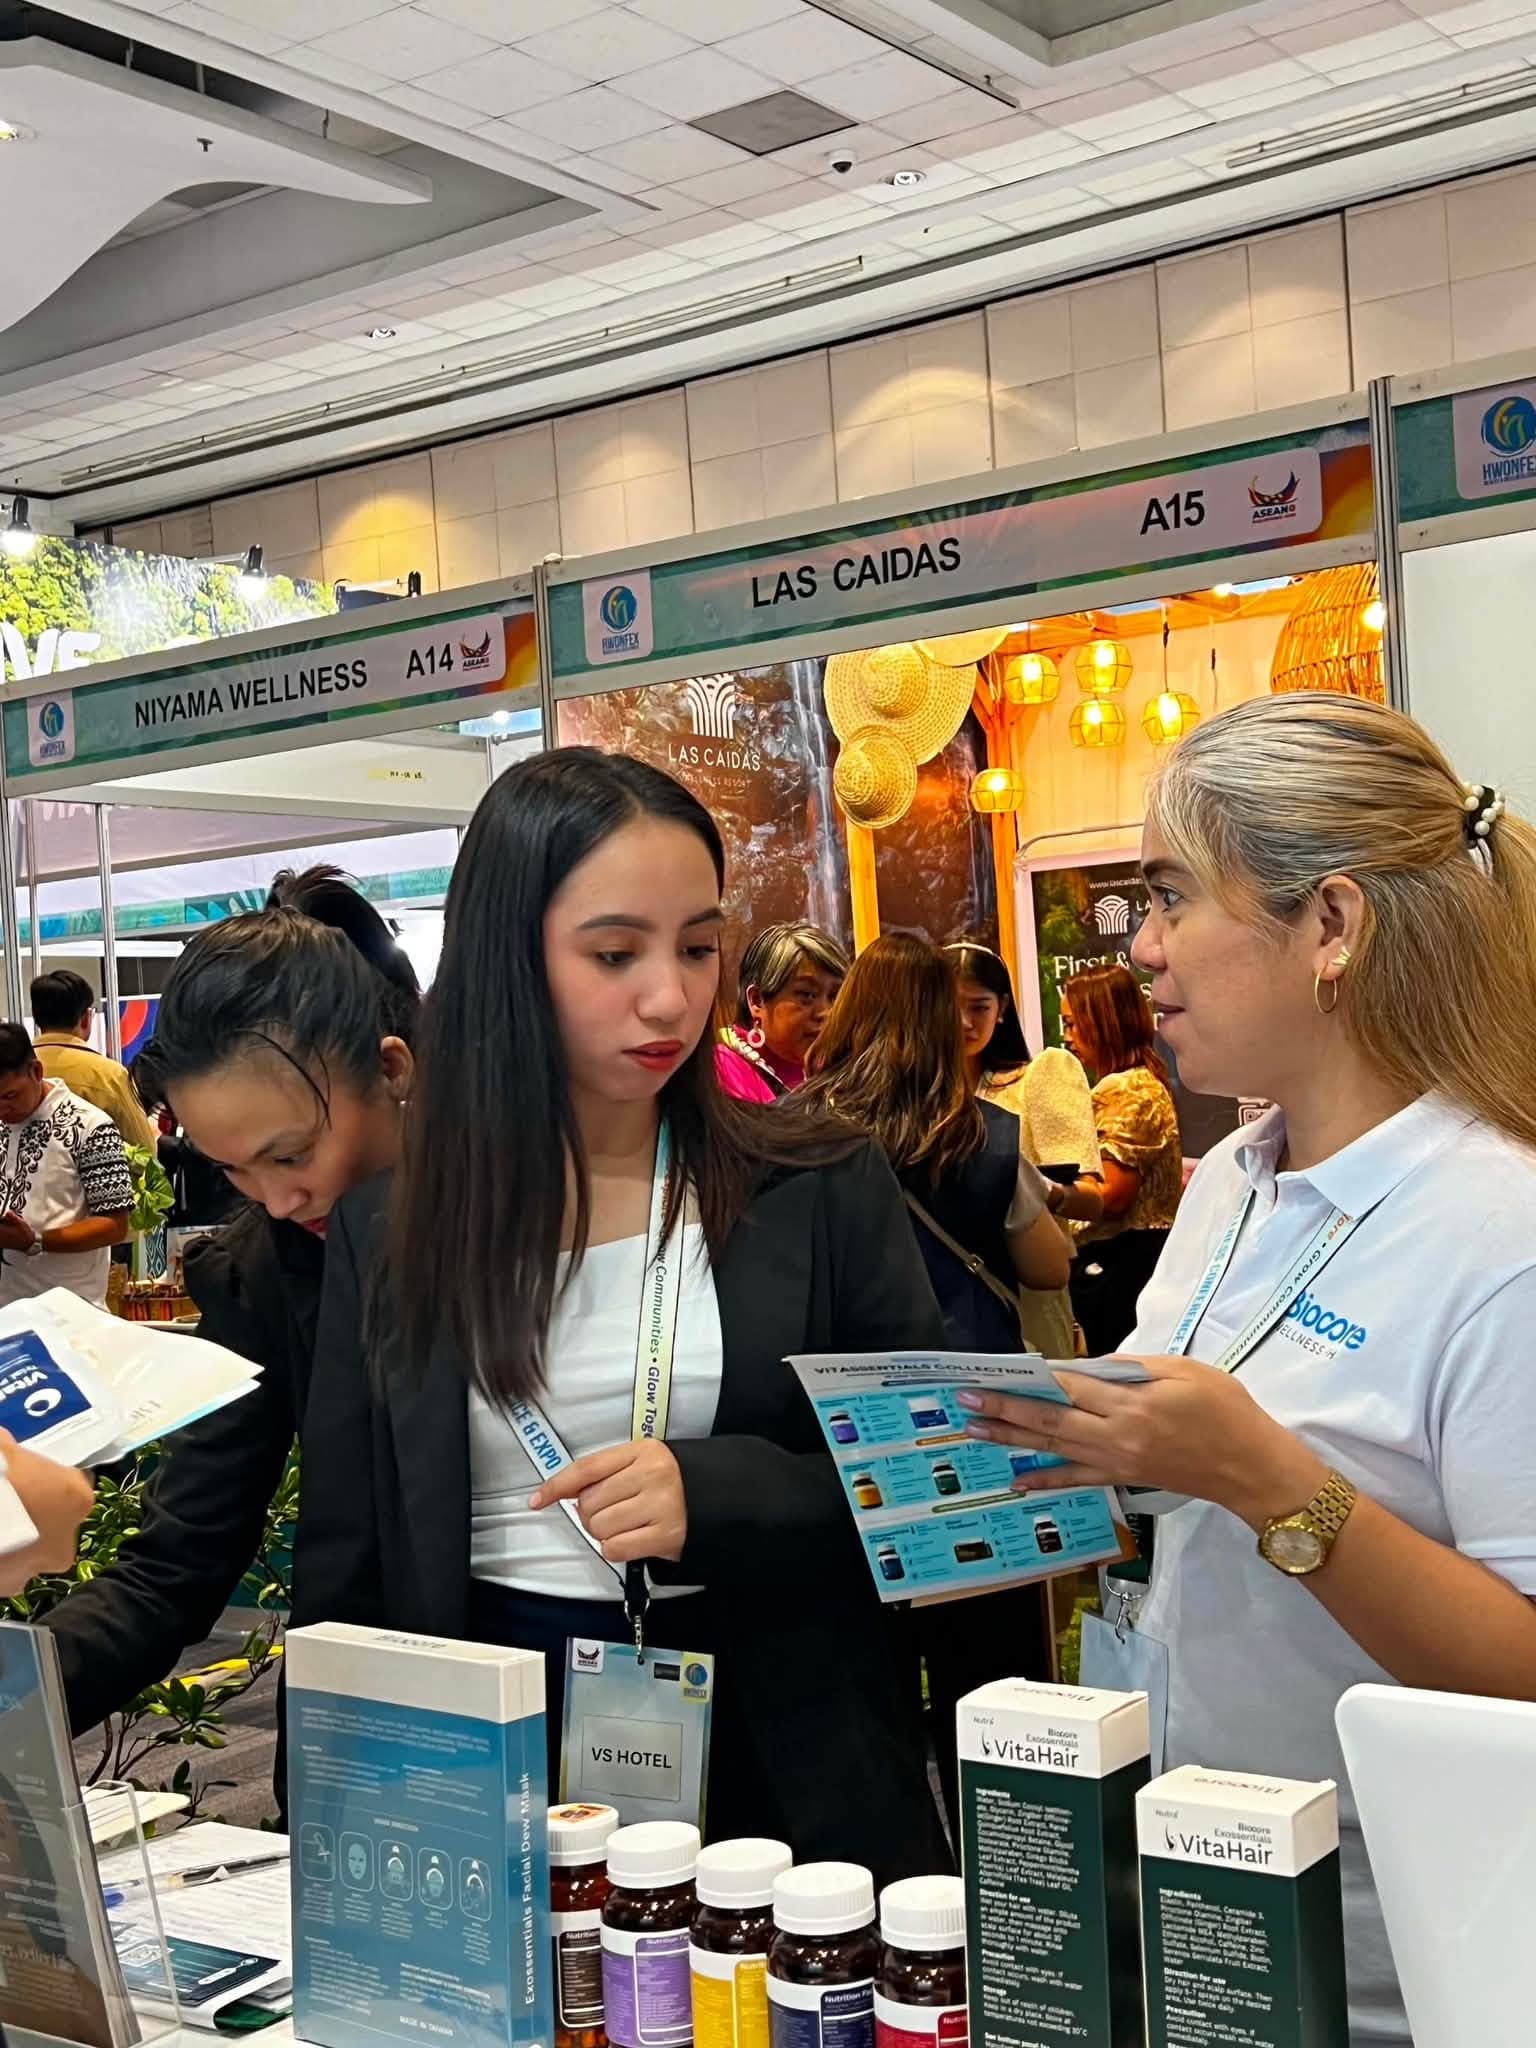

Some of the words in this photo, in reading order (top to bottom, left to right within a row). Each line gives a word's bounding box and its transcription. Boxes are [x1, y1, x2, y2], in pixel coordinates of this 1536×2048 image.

[1483, 456, 1536, 481] HWONFE
[1140, 490, 1205, 535] A15
[752, 564, 817, 608] LAS
[833, 537, 961, 592] CAIDAS
[406, 643, 453, 679] A14
[135, 689, 223, 729] NIYAMA
[228, 660, 368, 706] WELLNESS
[668, 743, 699, 764] LAS
[704, 748, 761, 771] CAIDAS
[1294, 1249, 1321, 1285] Grow
[650, 1264, 668, 1354] Communities
[1223, 1286, 1293, 1367] Communities
[645, 1366, 661, 1404] Glow
[522, 1421, 540, 1436] &
[528, 1433, 562, 1471] EXPO
[591, 1747, 612, 1763] VS
[617, 1751, 672, 1769] HOTEL
[994, 1739, 1079, 1769] VitaHair
[520, 1772, 530, 1814] Mask
[521, 1817, 531, 1852] Dew
[1179, 1833, 1273, 1865] VitaHair
[521, 1856, 533, 1903] Facial
[523, 1906, 536, 2005] Exossentials
[1164, 1966, 1197, 1981] Direction
[1200, 1973, 1210, 1982] for
[824, 1992, 861, 2003] Nutrition
